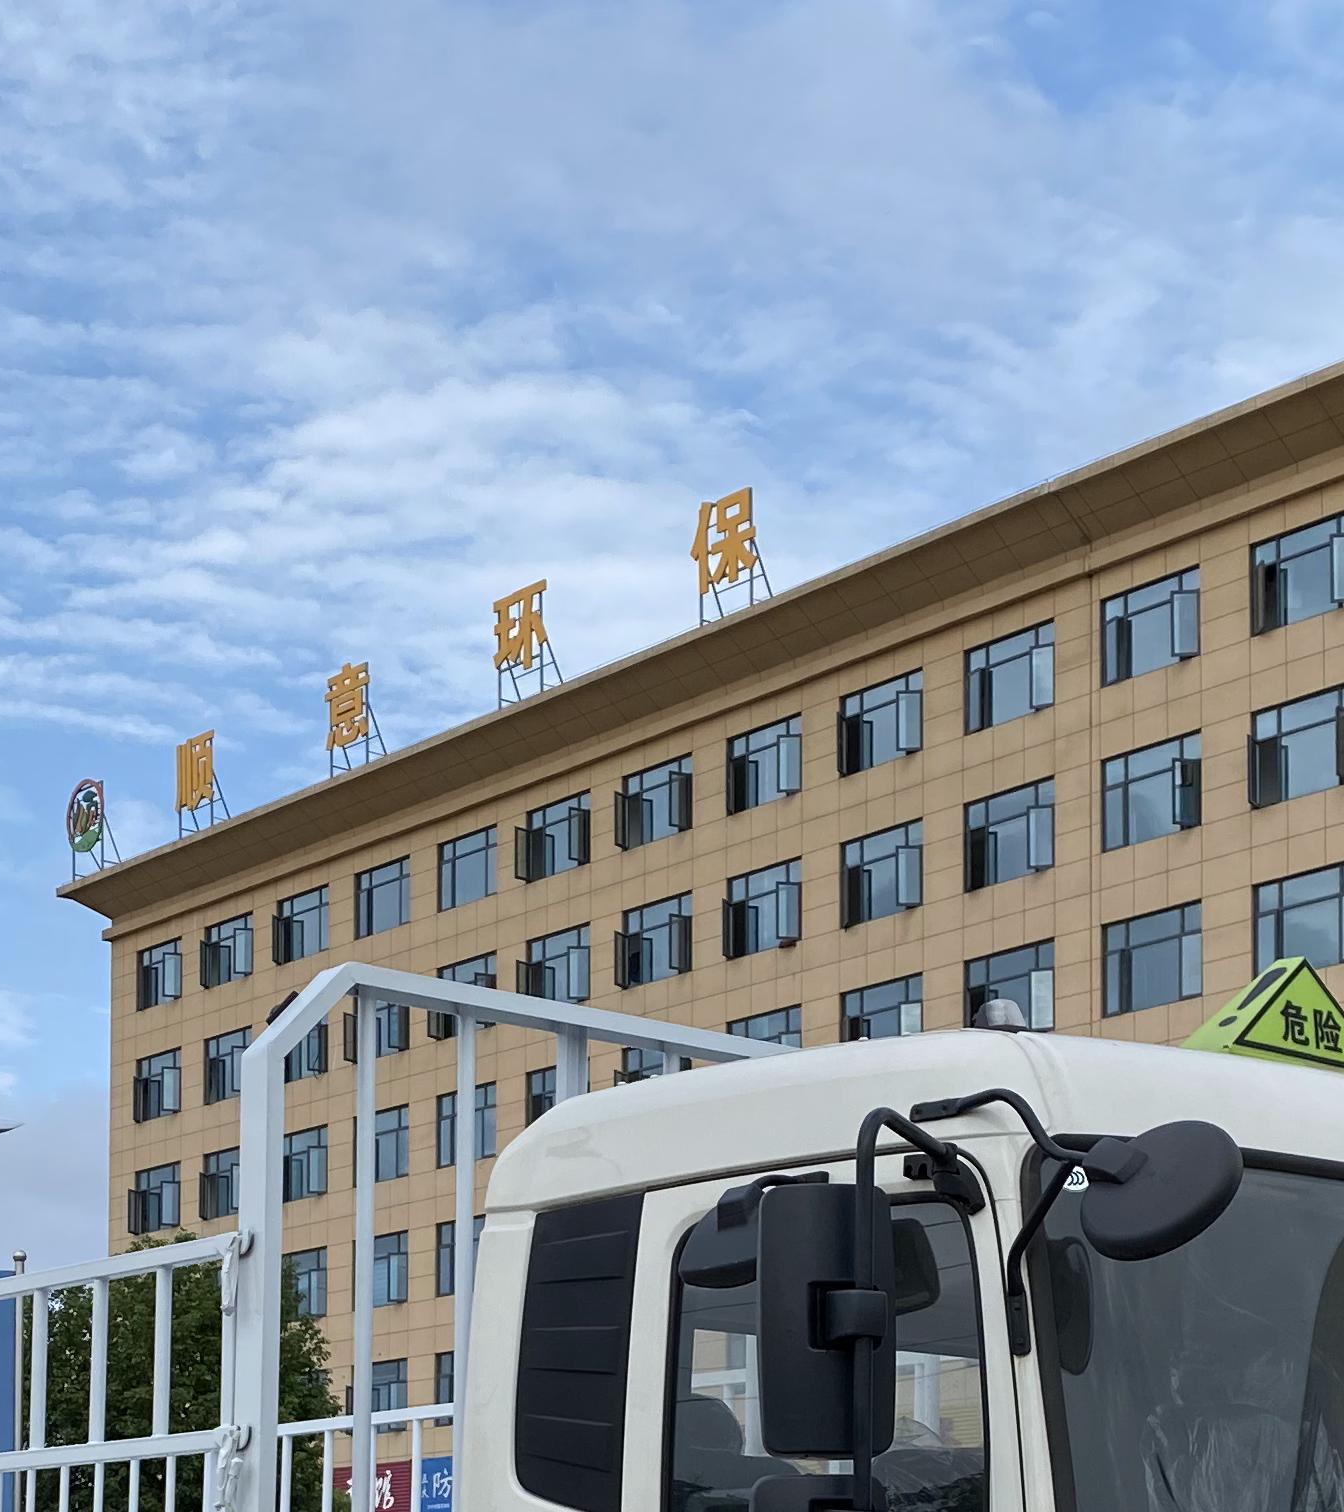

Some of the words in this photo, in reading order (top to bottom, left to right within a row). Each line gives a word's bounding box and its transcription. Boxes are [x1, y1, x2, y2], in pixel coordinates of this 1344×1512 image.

[175, 486, 757, 813] 顺意环保
[1280, 1000, 1343, 1053] 危险
